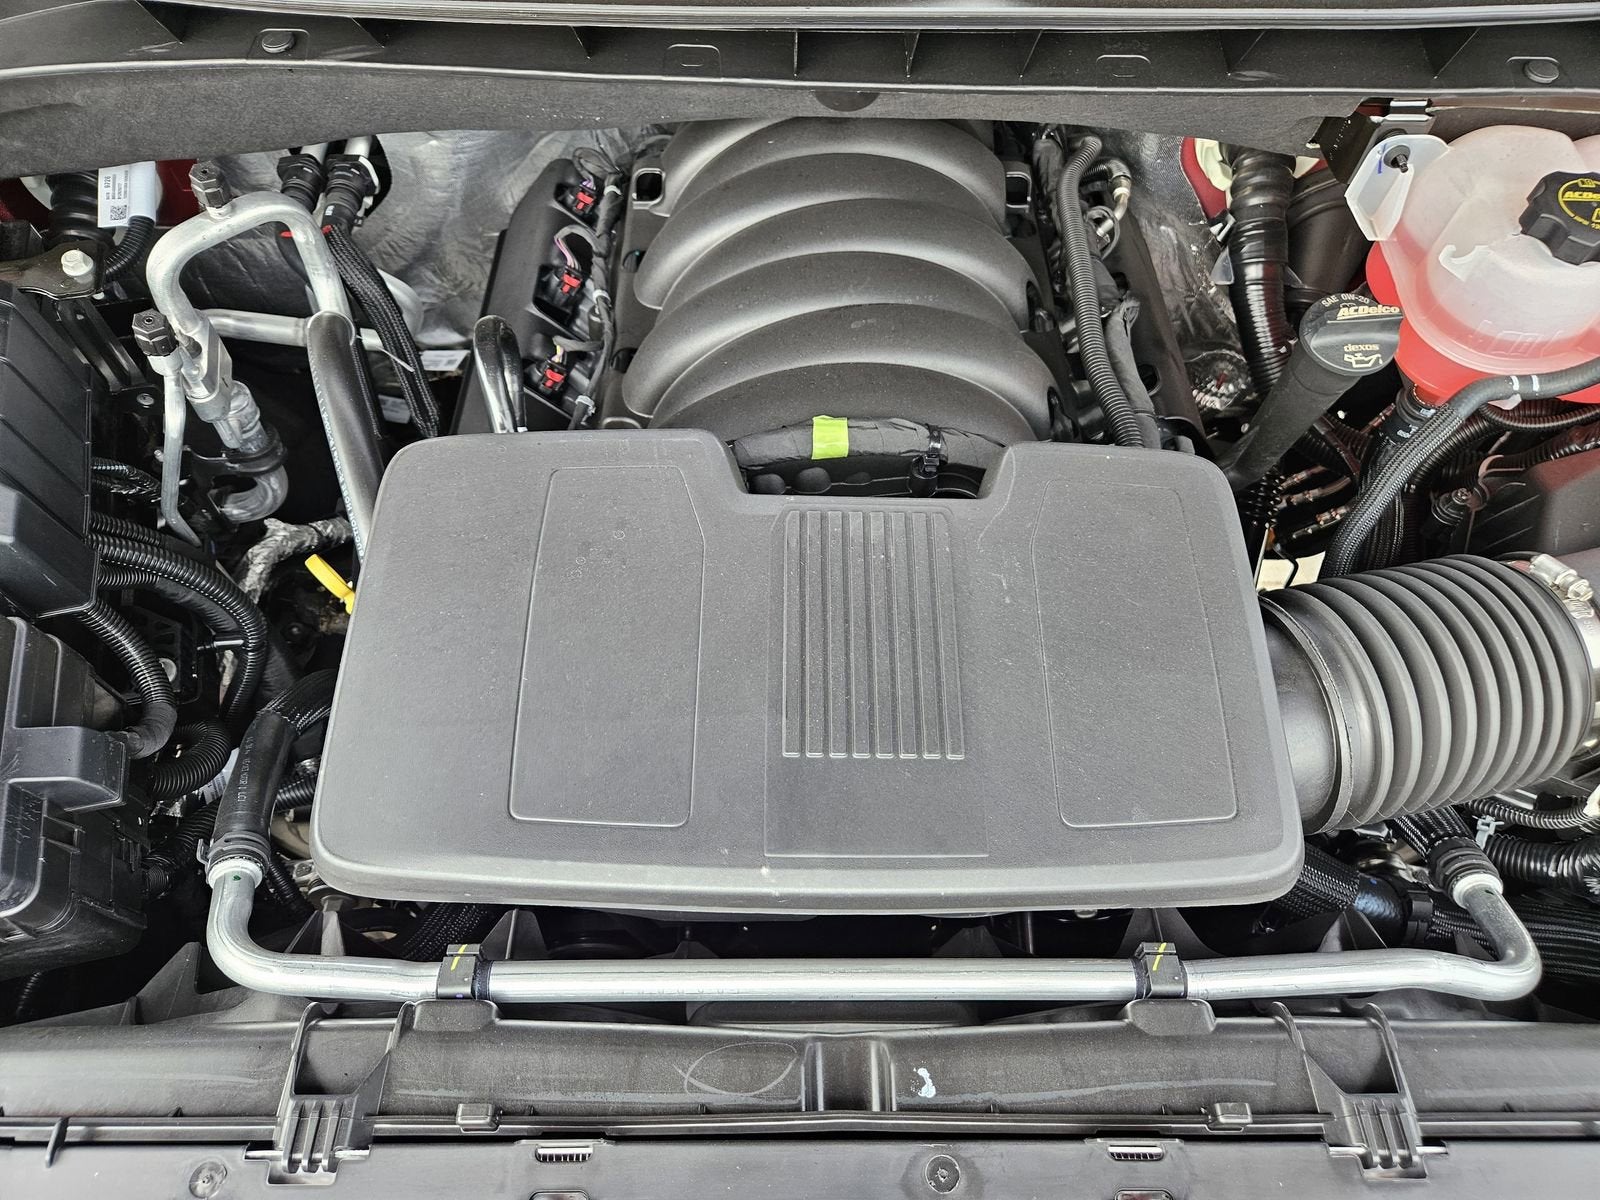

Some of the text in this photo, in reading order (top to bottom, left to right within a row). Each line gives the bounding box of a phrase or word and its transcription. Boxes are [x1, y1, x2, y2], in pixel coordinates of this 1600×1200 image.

[1321, 293, 1370, 307] SAE 0W-20
[1336, 304, 1401, 319] ACDelco
[1343, 344, 1380, 353] dexos
